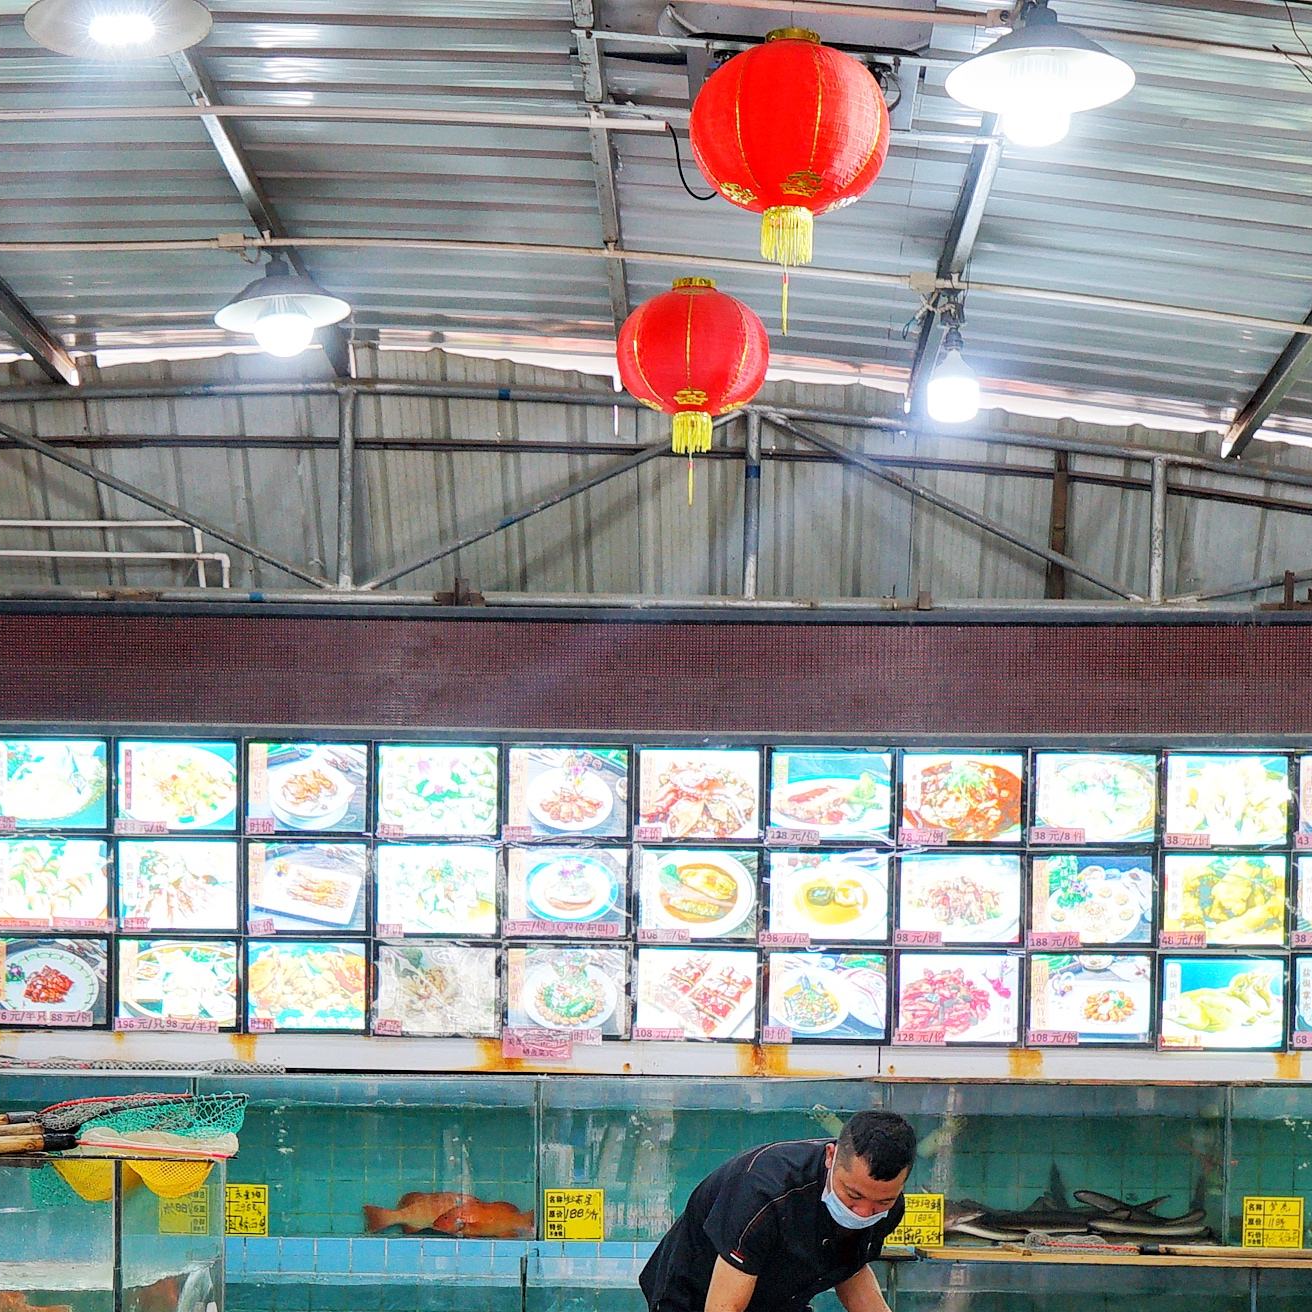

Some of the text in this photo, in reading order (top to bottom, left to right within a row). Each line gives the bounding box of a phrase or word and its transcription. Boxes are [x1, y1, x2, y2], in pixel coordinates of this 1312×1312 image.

[250, 820, 272, 831] 时价
[638, 829, 660, 843] 时价
[1167, 836, 1178, 844] 38
[901, 838, 913, 847] 78
[124, 919, 147, 929] 时价
[251, 922, 273, 934] 时价
[642, 931, 658, 940] 108
[761, 934, 778, 942] 298
[897, 934, 908, 942] 98
[1295, 935, 1306, 943] 38
[1030, 938, 1048, 946] 188
[10, 1012, 46, 1021] 元/半只
[51, 1013, 92, 1023] 88 元/例
[181, 1020, 217, 1031] 元/半只
[251, 1019, 273, 1030] 时价
[574, 1031, 596, 1042] 时价
[636, 1029, 682, 1039] 108 元/
[765, 1029, 787, 1039] 时价
[897, 1033, 914, 1042] 128
[1031, 1034, 1048, 1042] 108
[1295, 1036, 1307, 1044] 68
[1248, 1203, 1262, 1211] 名称
[549, 1210, 563, 1218] 原价
[1248, 1218, 1262, 1226] 原价
[549, 1223, 563, 1231] 特价
